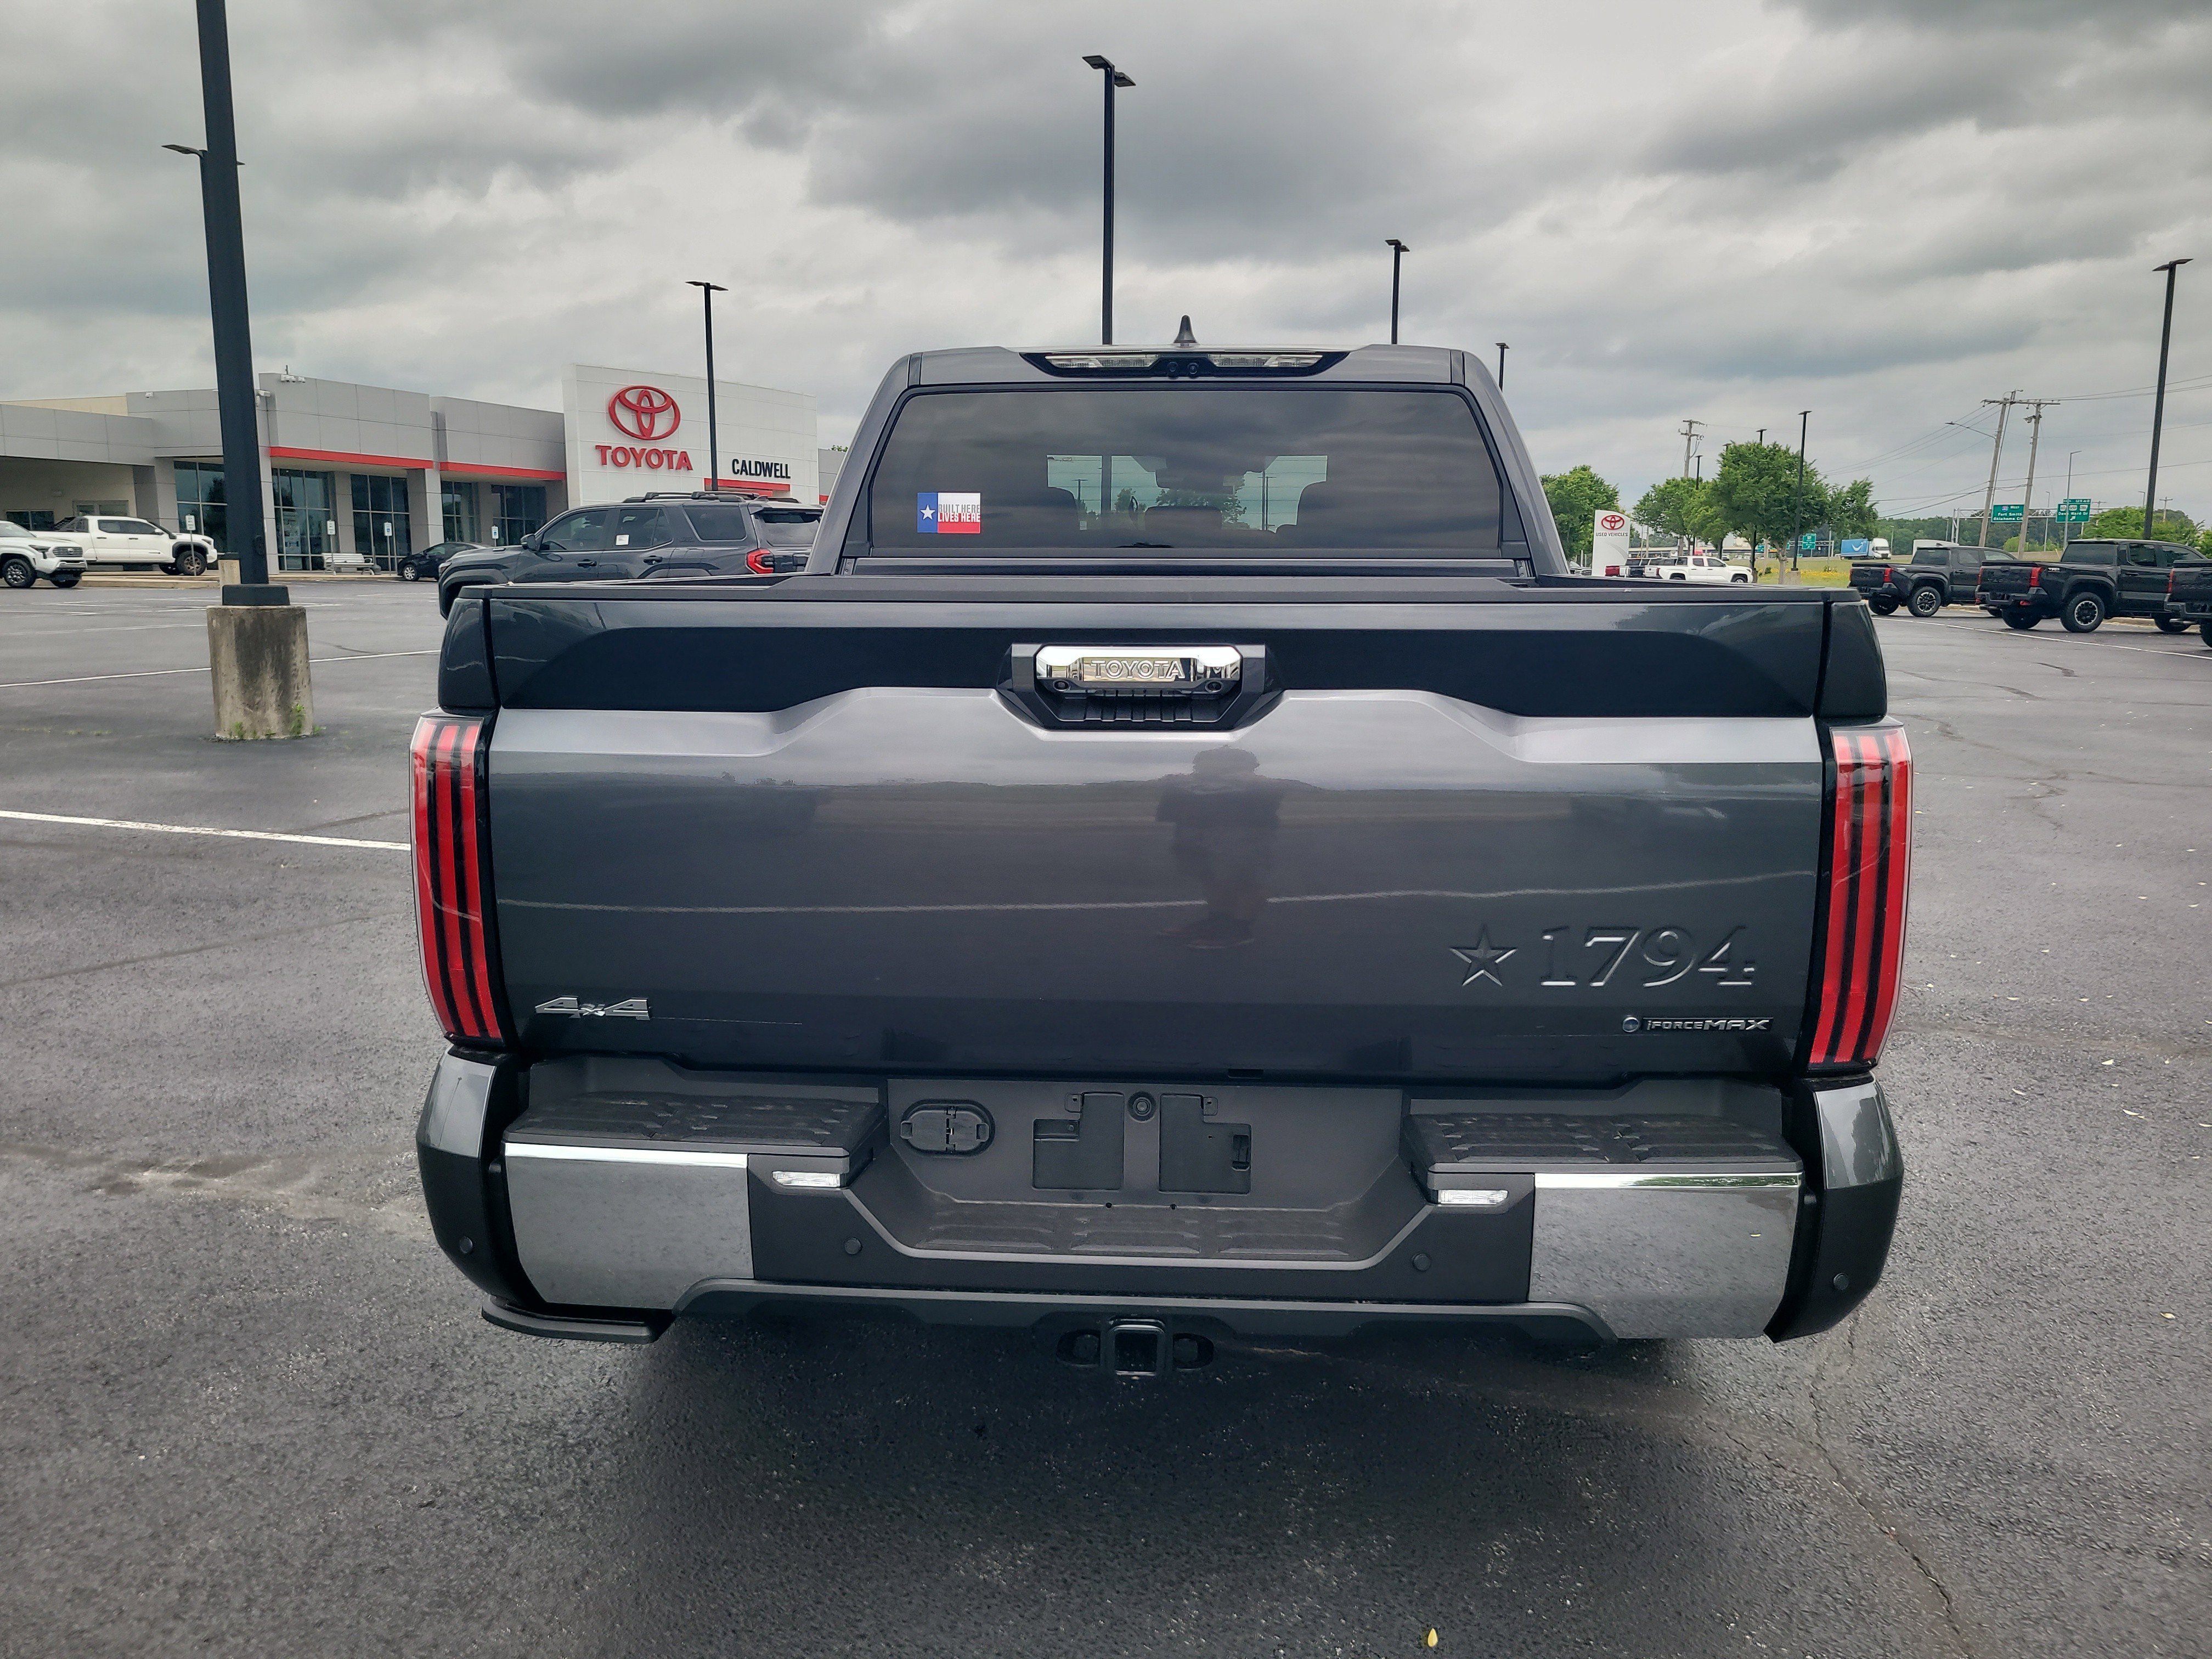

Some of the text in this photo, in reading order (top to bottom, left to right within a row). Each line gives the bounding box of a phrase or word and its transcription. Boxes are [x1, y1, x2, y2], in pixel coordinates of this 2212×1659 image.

[595, 445, 693, 471] TOYOTA
[732, 459, 791, 479] CALDWELL
[938, 512, 980, 522] LIVES HERE
[939, 504, 980, 513] BUILT HERE
[1091, 660, 1186, 679] TOYOTA
[1540, 926, 1756, 988] 1794
[535, 995, 651, 1021] 4x4
